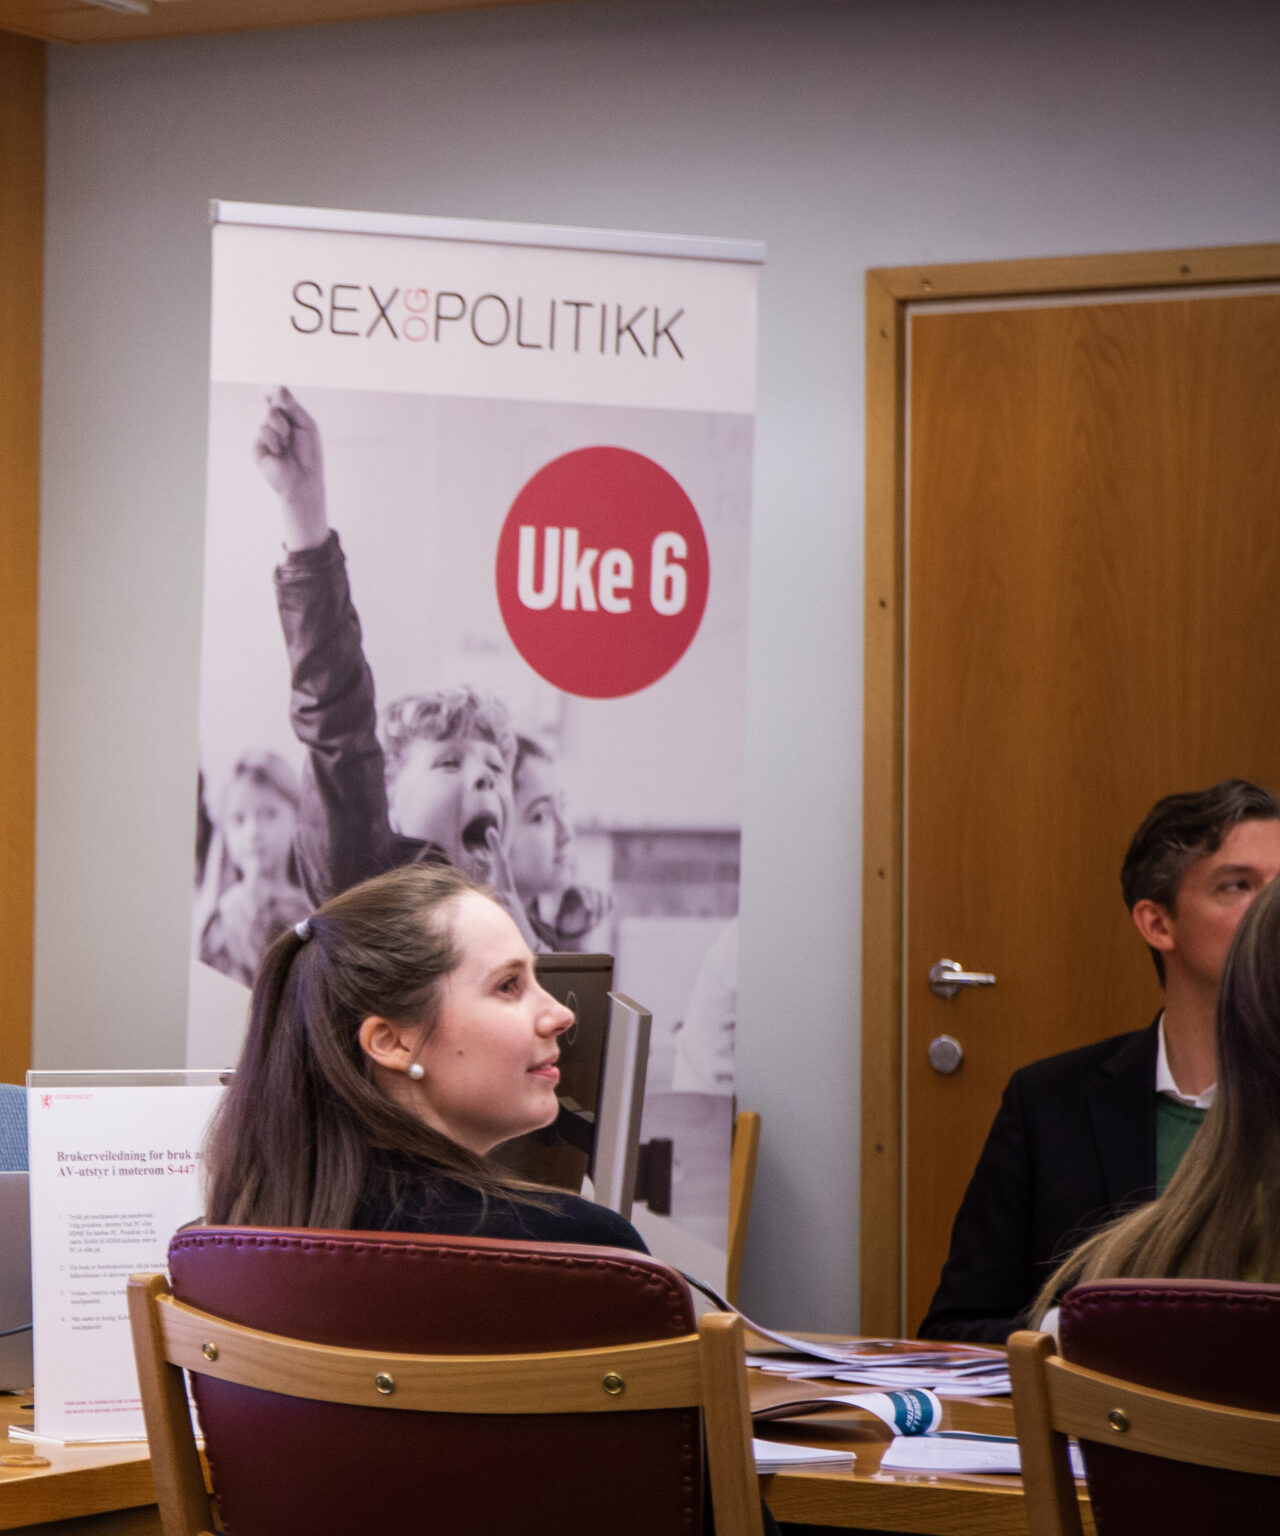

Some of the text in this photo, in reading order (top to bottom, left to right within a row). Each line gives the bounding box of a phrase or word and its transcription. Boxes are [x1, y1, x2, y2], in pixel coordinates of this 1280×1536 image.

[290, 280, 687, 361] SEX OG POLITIKK
[517, 525, 689, 617] Uke 6
[56, 1150, 147, 1163] Brukerveiledning
[149, 1150, 164, 1161] for
[167, 1149, 191, 1161] bruk
[56, 1166, 109, 1179] AV-utstyr
[111, 1165, 116, 1176] i
[118, 1166, 165, 1177] møterom
